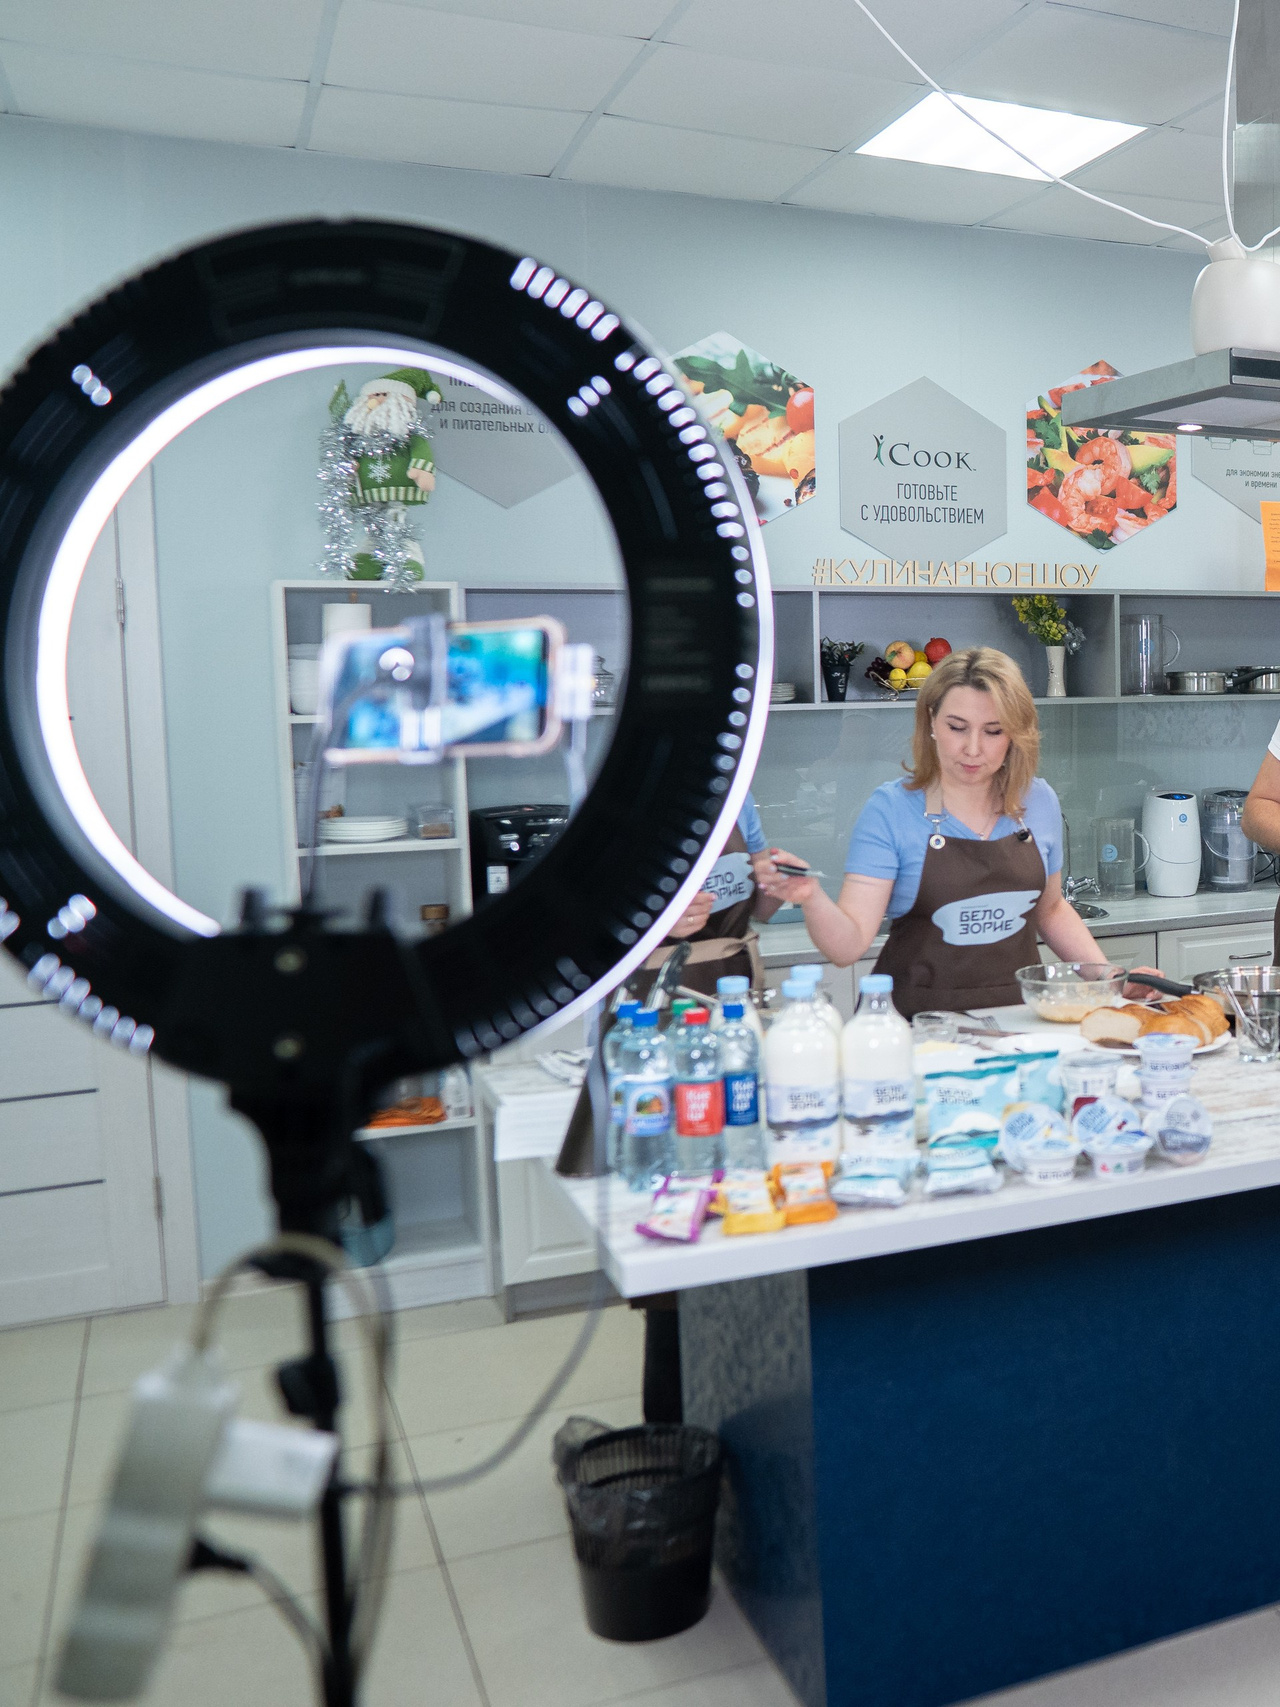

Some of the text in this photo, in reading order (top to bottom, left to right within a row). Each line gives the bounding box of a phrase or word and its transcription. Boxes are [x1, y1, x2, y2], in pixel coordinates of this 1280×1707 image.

[461, 401, 522, 416] создания
[440, 419, 448, 429] и
[453, 419, 534, 433] питательных
[1225, 469, 1238, 477] для
[1239, 470, 1270, 478] экономии
[897, 483, 958, 502] ГОТОВЬТЕ
[1251, 481, 1278, 489] времени
[861, 504, 984, 525] С УДОВОЛЬСТВИЕМ
[811, 557, 1099, 589] #КУЛИНАРНОЕШОУ
[960, 908, 1005, 922] БЕЛО
[959, 919, 1014, 935] ЗОРИЕ
